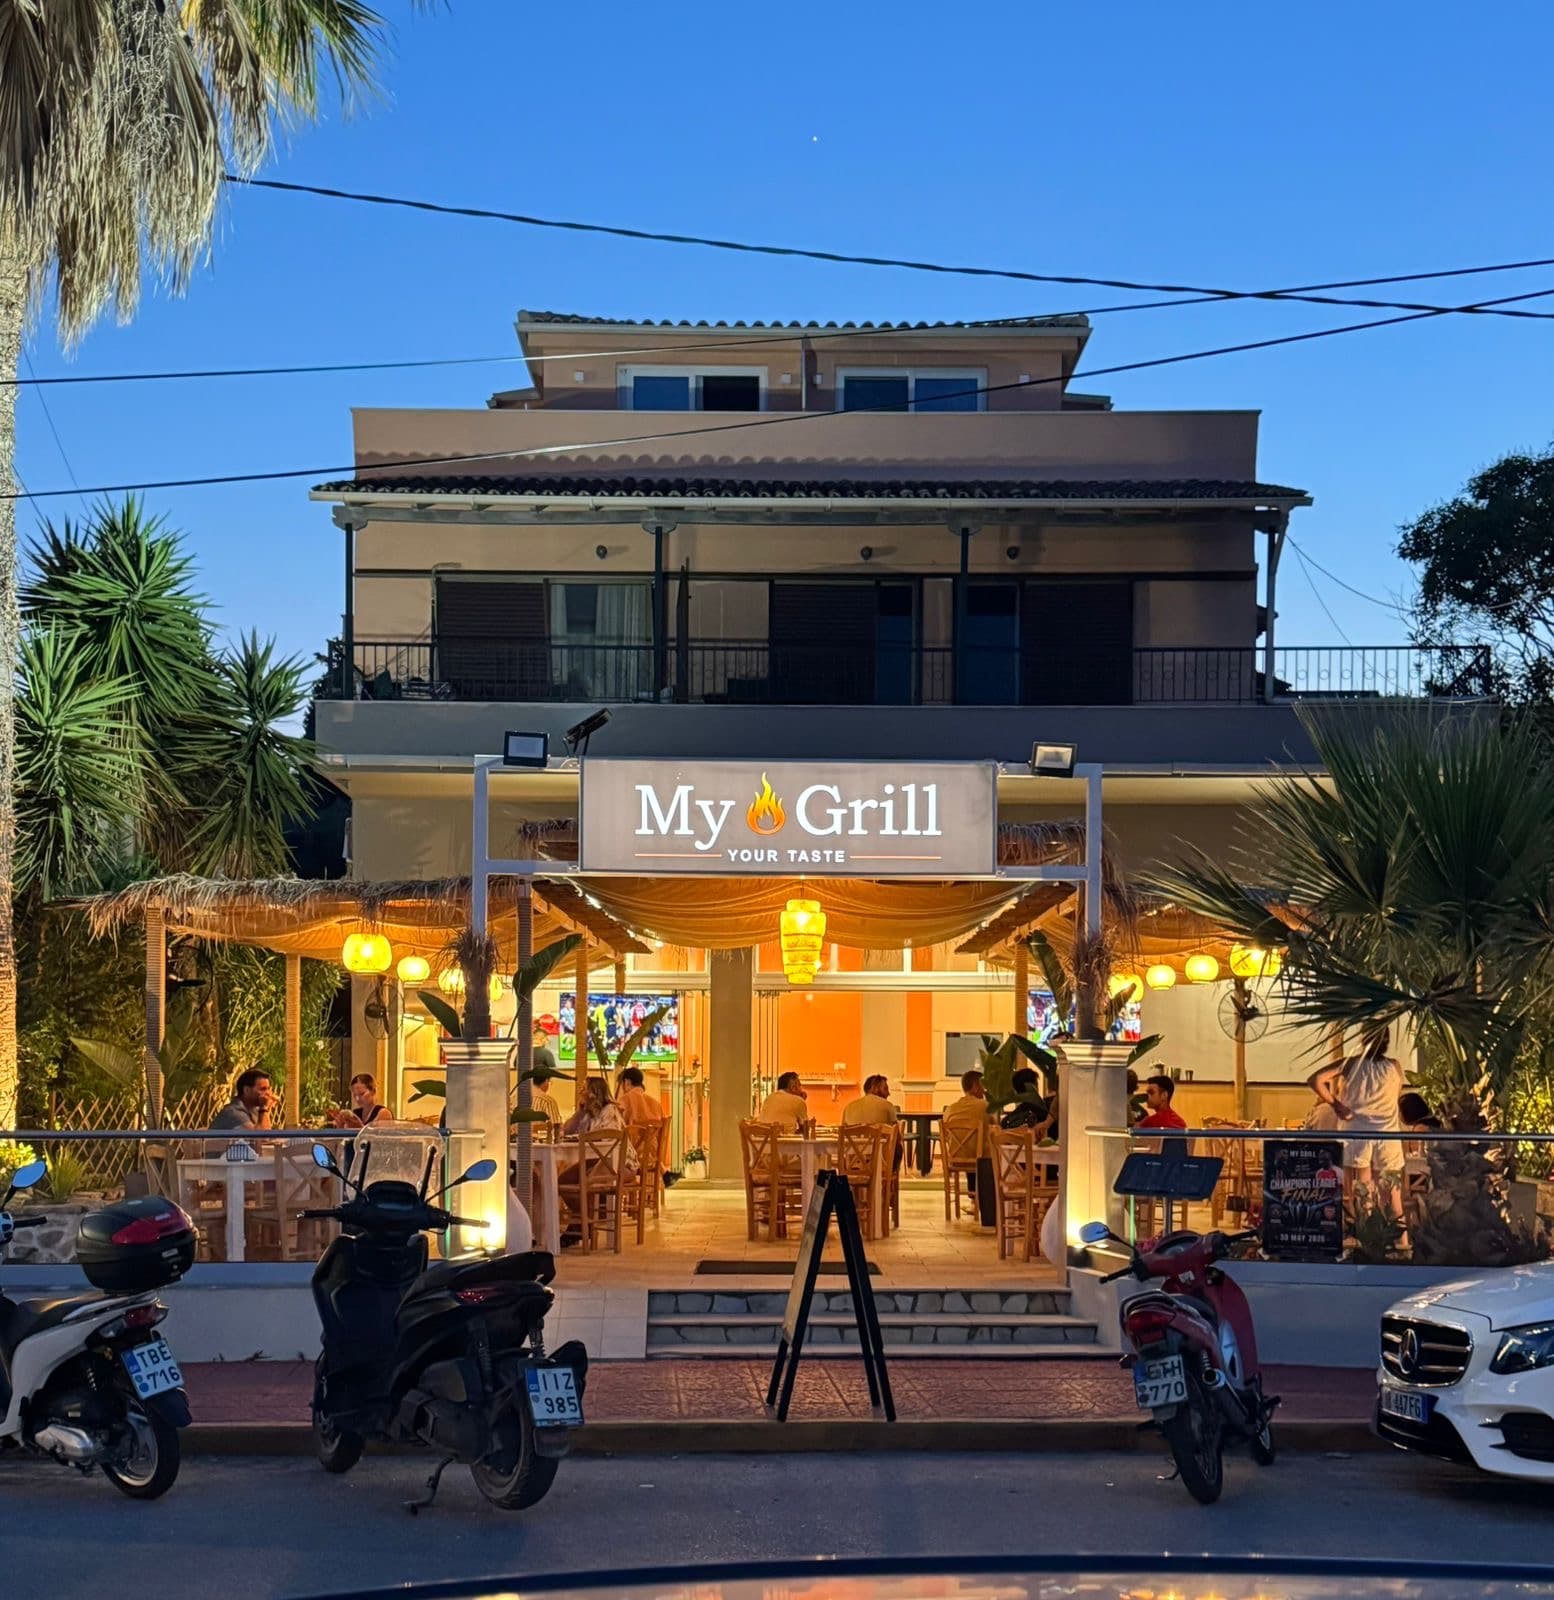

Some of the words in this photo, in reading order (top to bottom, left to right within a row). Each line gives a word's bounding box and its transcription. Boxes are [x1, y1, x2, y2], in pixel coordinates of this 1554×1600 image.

[634, 784, 736, 850] My
[795, 783, 942, 836] Grill
[727, 849, 779, 862] YOUR
[787, 850, 846, 863] TASTE
[1270, 1179, 1311, 1190] CHAMPIONS
[1312, 1178, 1337, 1188] LEAGUE
[1281, 1187, 1329, 1203] FINAL
[137, 1342, 172, 1368] TBE
[146, 1366, 180, 1390] 716
[1149, 1381, 1185, 1401] 770
[544, 1396, 578, 1414] 985
